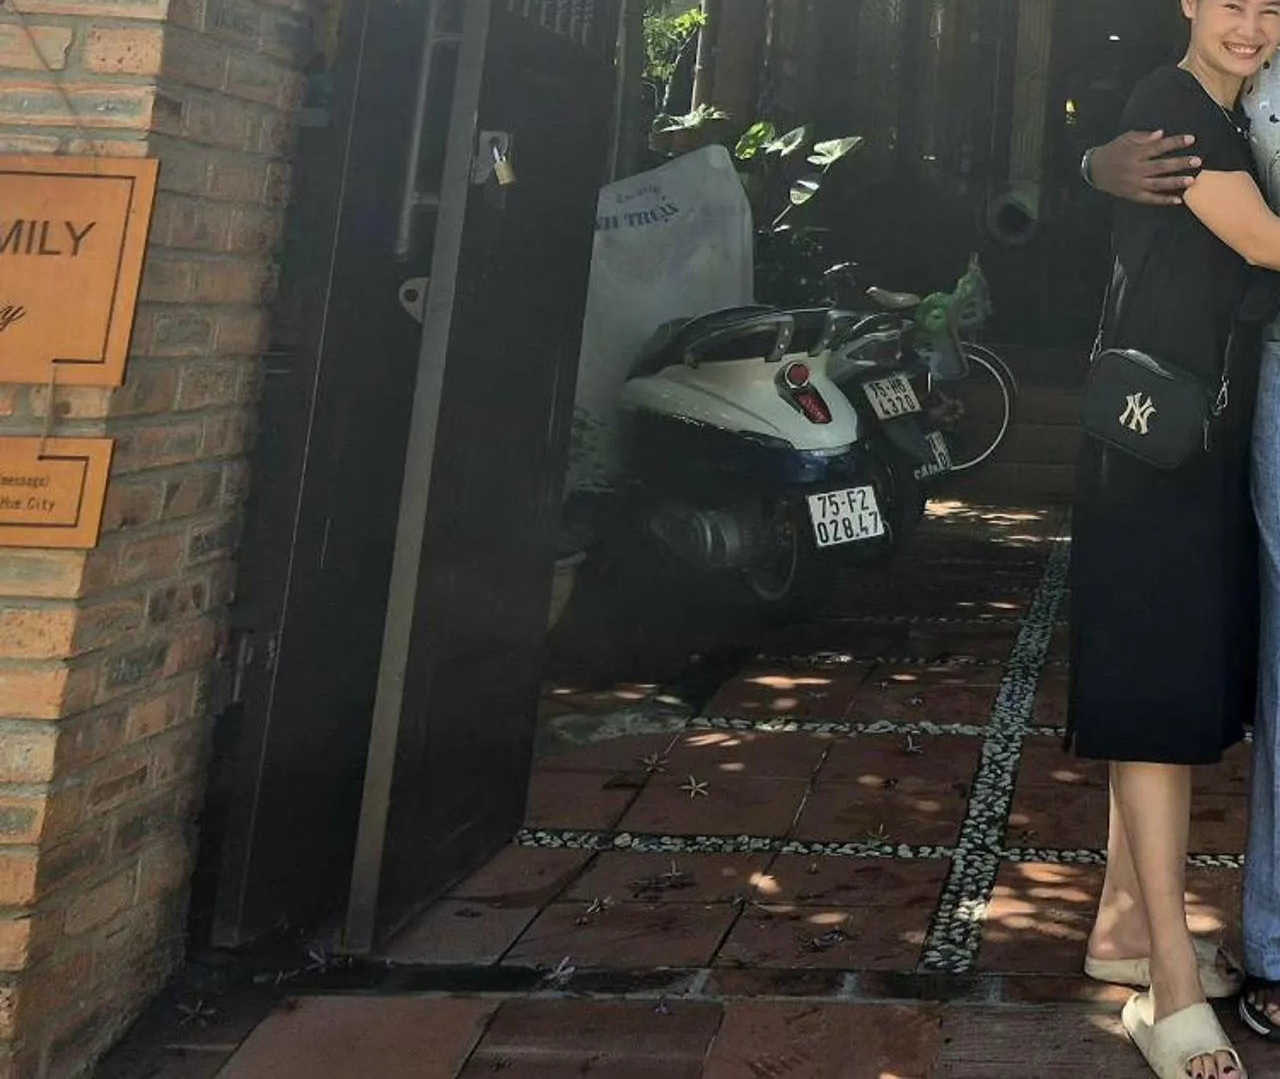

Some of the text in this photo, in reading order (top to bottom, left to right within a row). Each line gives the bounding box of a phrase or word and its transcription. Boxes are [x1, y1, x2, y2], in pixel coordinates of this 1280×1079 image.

[1119, 392, 1157, 434] NY
[817, 489, 869, 519] 75-F2
[817, 512, 879, 544] 028.47
